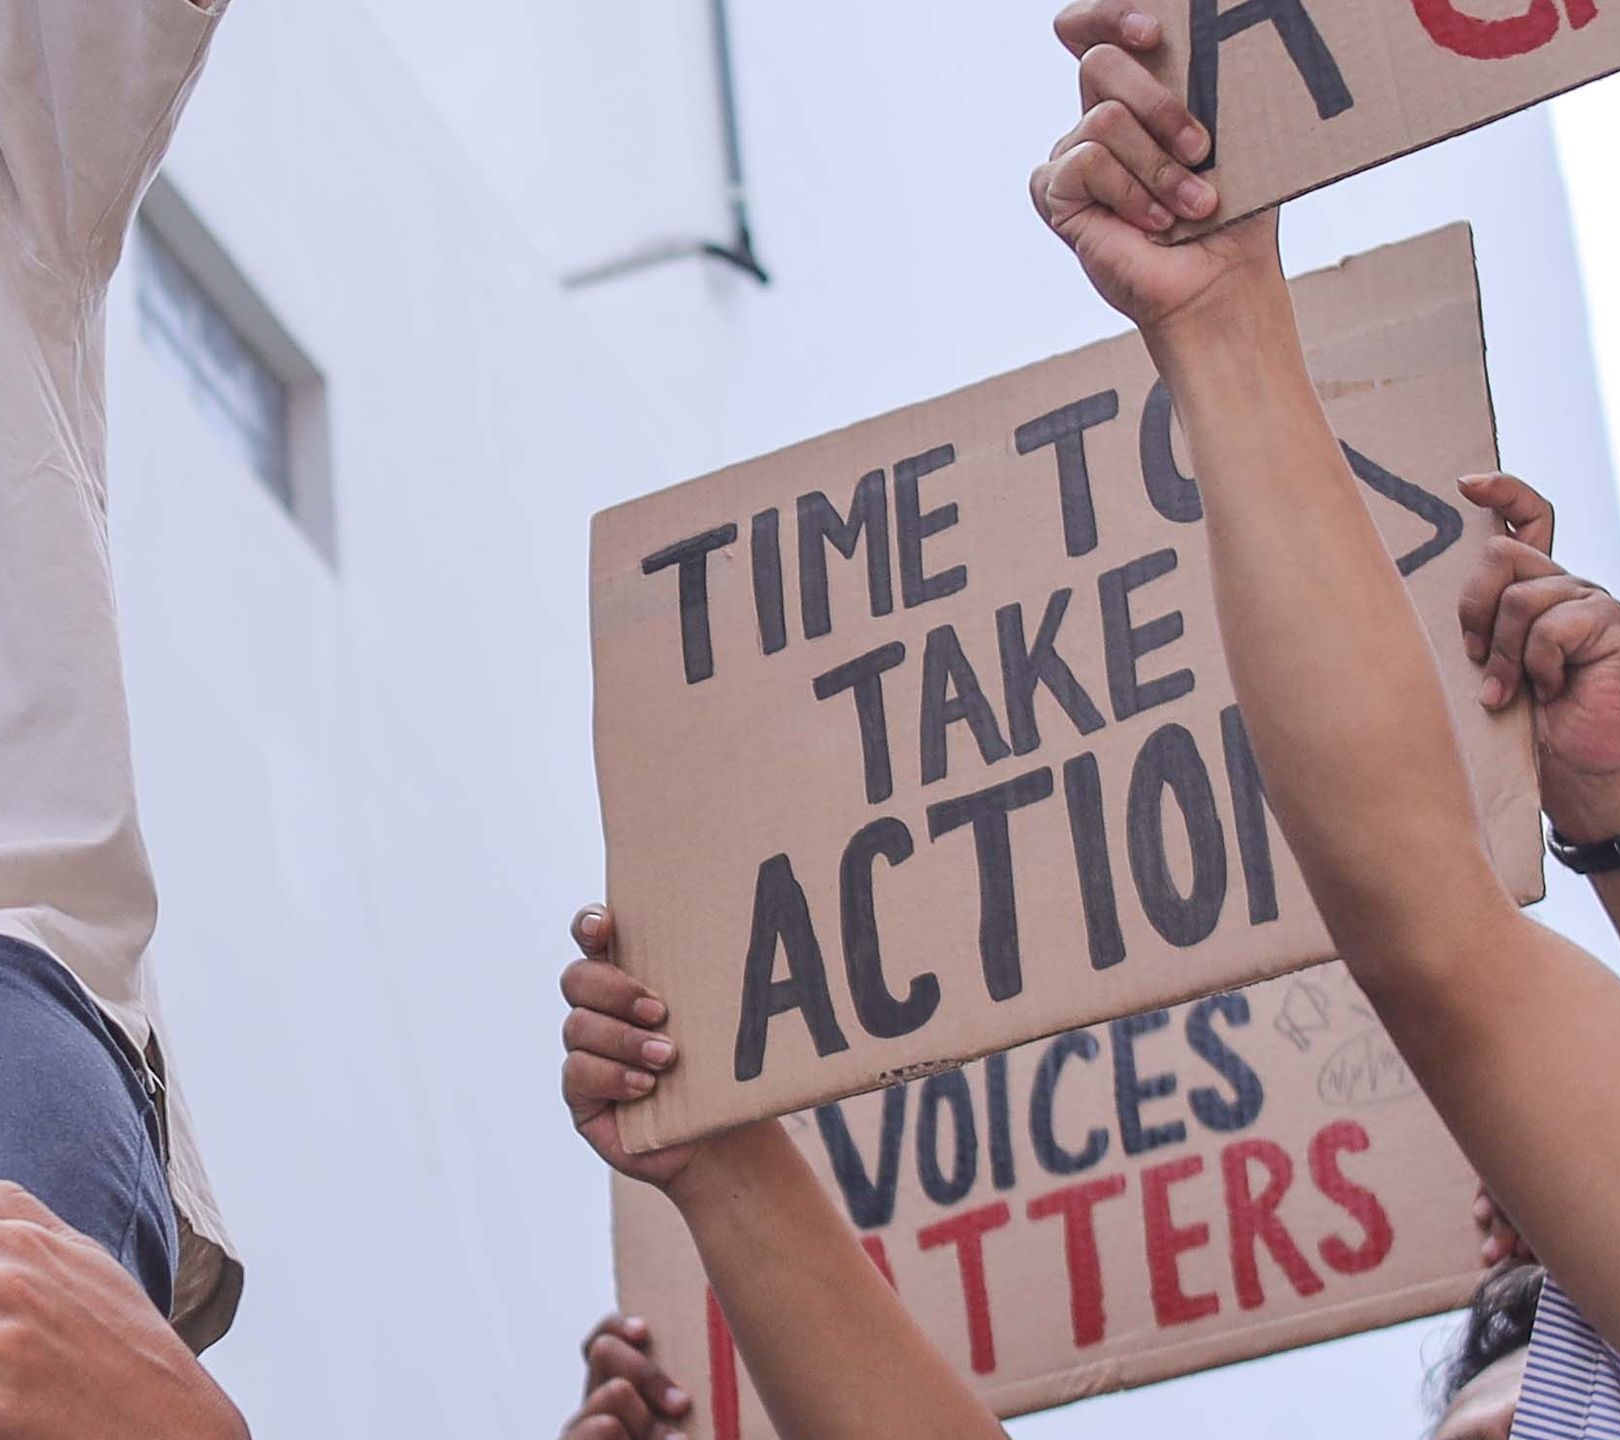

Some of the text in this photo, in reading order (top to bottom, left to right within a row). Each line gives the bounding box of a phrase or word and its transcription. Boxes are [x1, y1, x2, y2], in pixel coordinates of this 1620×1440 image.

[642, 444, 967, 685] TIME
[813, 548, 1197, 805] TAKE
[815, 991, 1264, 1230] VOICES
